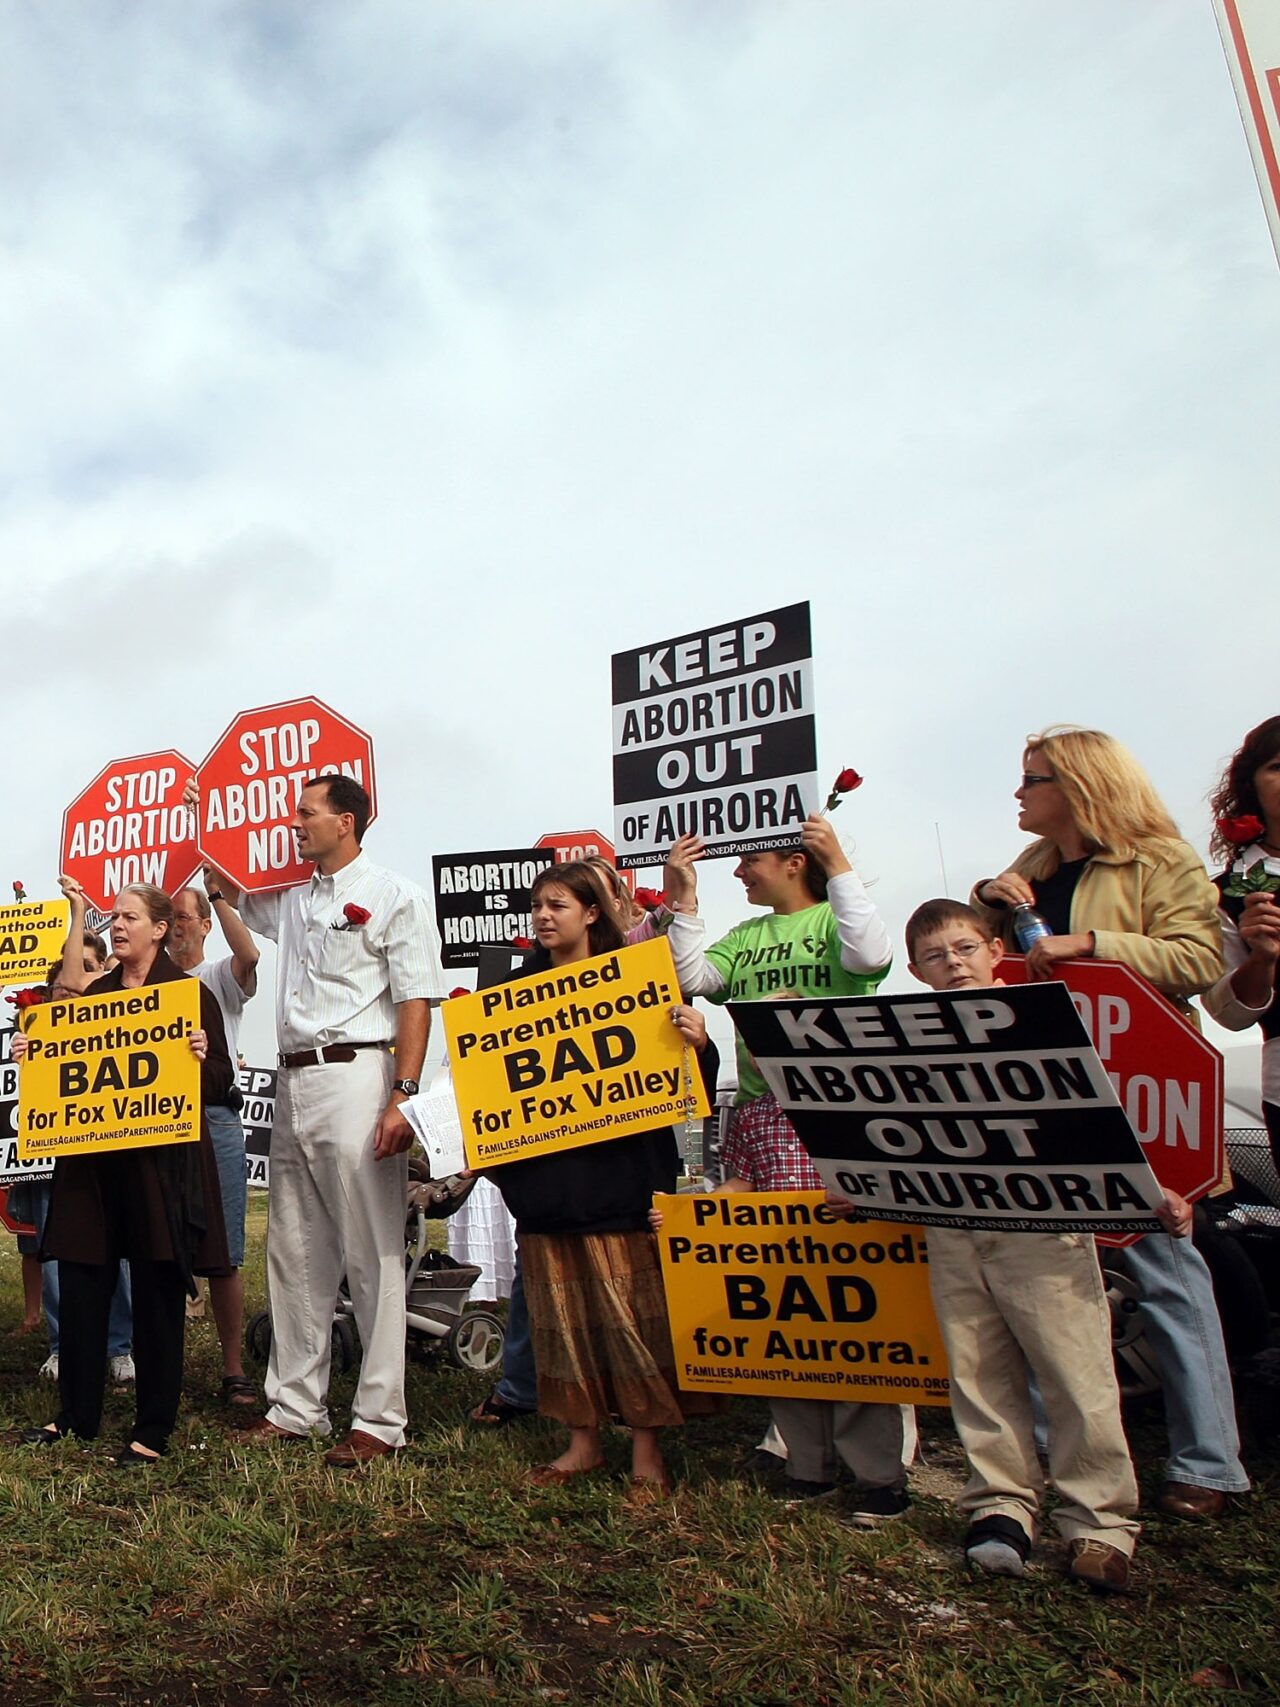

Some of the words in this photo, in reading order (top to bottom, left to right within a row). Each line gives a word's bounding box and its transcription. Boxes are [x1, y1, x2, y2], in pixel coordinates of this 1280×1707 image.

[639, 621, 776, 692] KEEP
[621, 669, 803, 747] ABORTION
[239, 718, 320, 776] STOP
[657, 733, 762, 789] OUT
[105, 767, 176, 813] STOP
[206, 759, 364, 832] ABORTN
[69, 805, 195, 859] ABORTIO
[623, 815, 649, 842] OF
[654, 784, 805, 844] AURORA
[103, 850, 168, 897] NOW
[485, 894, 508, 910] IS
[444, 913, 537, 945] HOMICI
[482, 956, 621, 1017] Planned
[732, 979, 747, 998] or
[755, 965, 831, 992] TRUTH
[51, 989, 160, 1027] Planned
[457, 981, 671, 1058] Parenthood:
[774, 999, 1015, 1049] KEEP
[27, 1016, 192, 1061] Parenthood:
[503, 1025, 637, 1093] BAD
[59, 1051, 159, 1098] BAD
[782, 1057, 1098, 1104] ABORTION
[27, 1108, 57, 1131] for
[64, 1103, 105, 1126] Fox
[113, 1093, 192, 1120] Valley.
[472, 1106, 512, 1135] for
[521, 1094, 574, 1124] Fox
[865, 1118, 1039, 1158] OUT
[835, 1171, 879, 1196] OF
[889, 1170, 1152, 1211] AURORA
[856, 1209, 1161, 1231] AMILIESAGAINSTPLANNEDPARENTHOOD.ORG
[668, 1234, 928, 1264] Parenthood:
[724, 1274, 877, 1323] BAD
[693, 1327, 749, 1357] for
[764, 1330, 929, 1365] Aurora.
